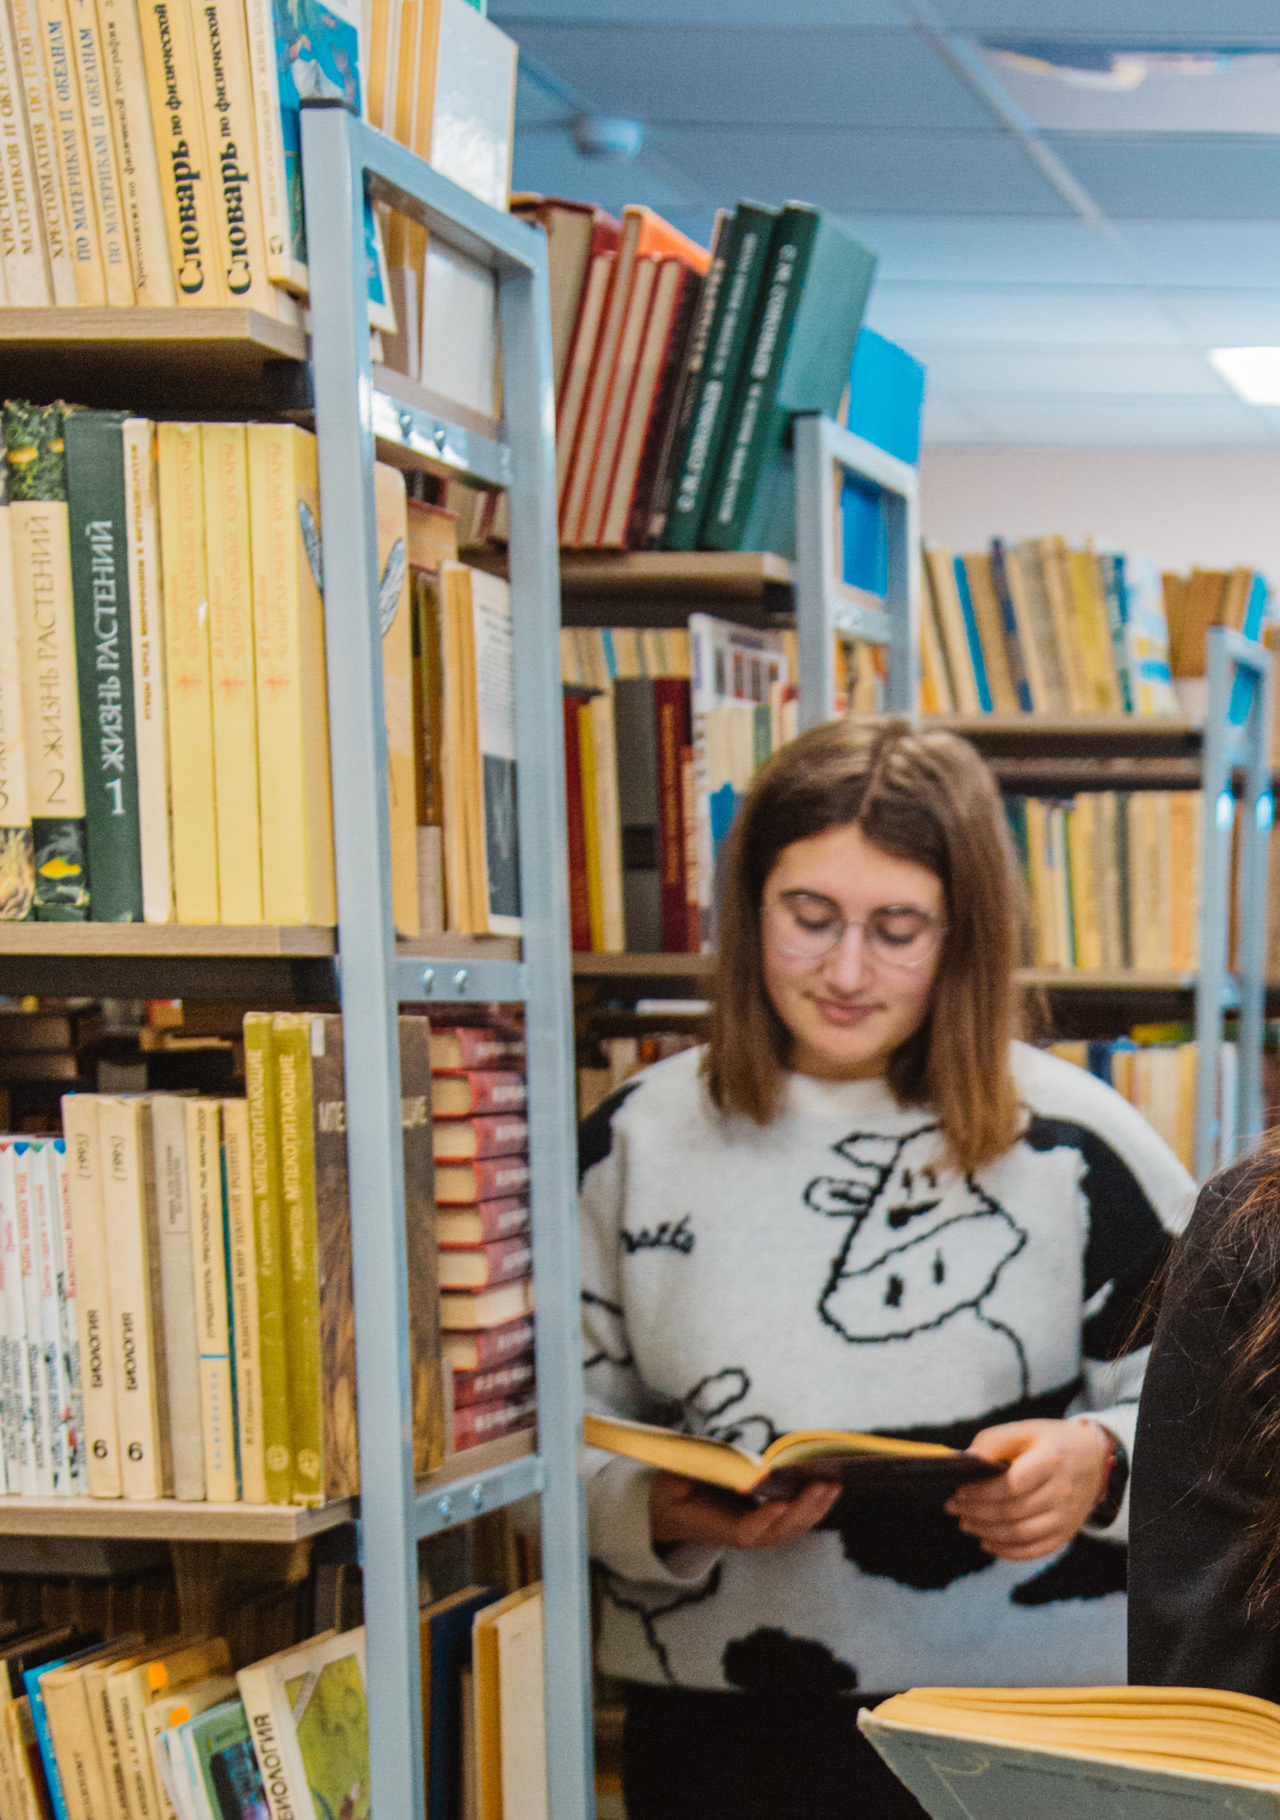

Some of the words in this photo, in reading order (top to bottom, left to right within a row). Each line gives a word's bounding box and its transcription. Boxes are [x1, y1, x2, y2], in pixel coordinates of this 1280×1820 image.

[47, 20, 70, 101] ОКЕАНАМ
[78, 28, 102, 108] ОКЕАНАМ
[106, 20, 126, 92] географии
[153, 3, 182, 112] физической
[203, 5, 232, 114] физической
[26, 86, 42, 113] ПО
[58, 108, 73, 122] И
[90, 114, 104, 127] И
[115, 98, 134, 175] физической
[168, 114, 182, 136] по
[217, 116, 231, 137] по
[7, 143, 32, 254] МАТЕРИКОВ
[32, 122, 64, 258] ХРЕСТОМАТИЯ
[61, 129, 87, 230] МАТЕРИКАМ
[92, 134, 119, 234] МАТЕРИКАМ
[127, 181, 137, 197] по
[162, 139, 212, 295] Словарь
[211, 140, 261, 296] Словарь
[75, 235, 91, 261] ПО
[106, 239, 121, 264] ПО
[126, 202, 148, 288] Хрестоматия
[24, 514, 59, 661] РАСТЕНИЙ
[84, 519, 121, 670] РАСТЕНИЙ
[36, 666, 66, 759] ЖИЗНЬ
[96, 675, 126, 772] ЖИЗНЬ
[43, 768, 66, 804] 2
[103, 778, 124, 815] 1
[73, 1132, 92, 1179] (1995)
[109, 1133, 128, 1181] (1995)
[246, 1049, 269, 1194] МЛЕКОПИТАЮЩИЕ
[276, 1053, 301, 1200] МЛЕКОПИТАЮЩИЕ
[227, 1133, 241, 1189] РОДИНЫ
[234, 1249, 246, 1277] МИР
[85, 1308, 104, 1387] БИОЛОГИЯ
[120, 1311, 138, 1390] БИОЛОГИЯ
[236, 1283, 252, 1358] ЖИВОТНЫЙ
[91, 1438, 108, 1459] 6
[126, 1441, 143, 1462] 6
